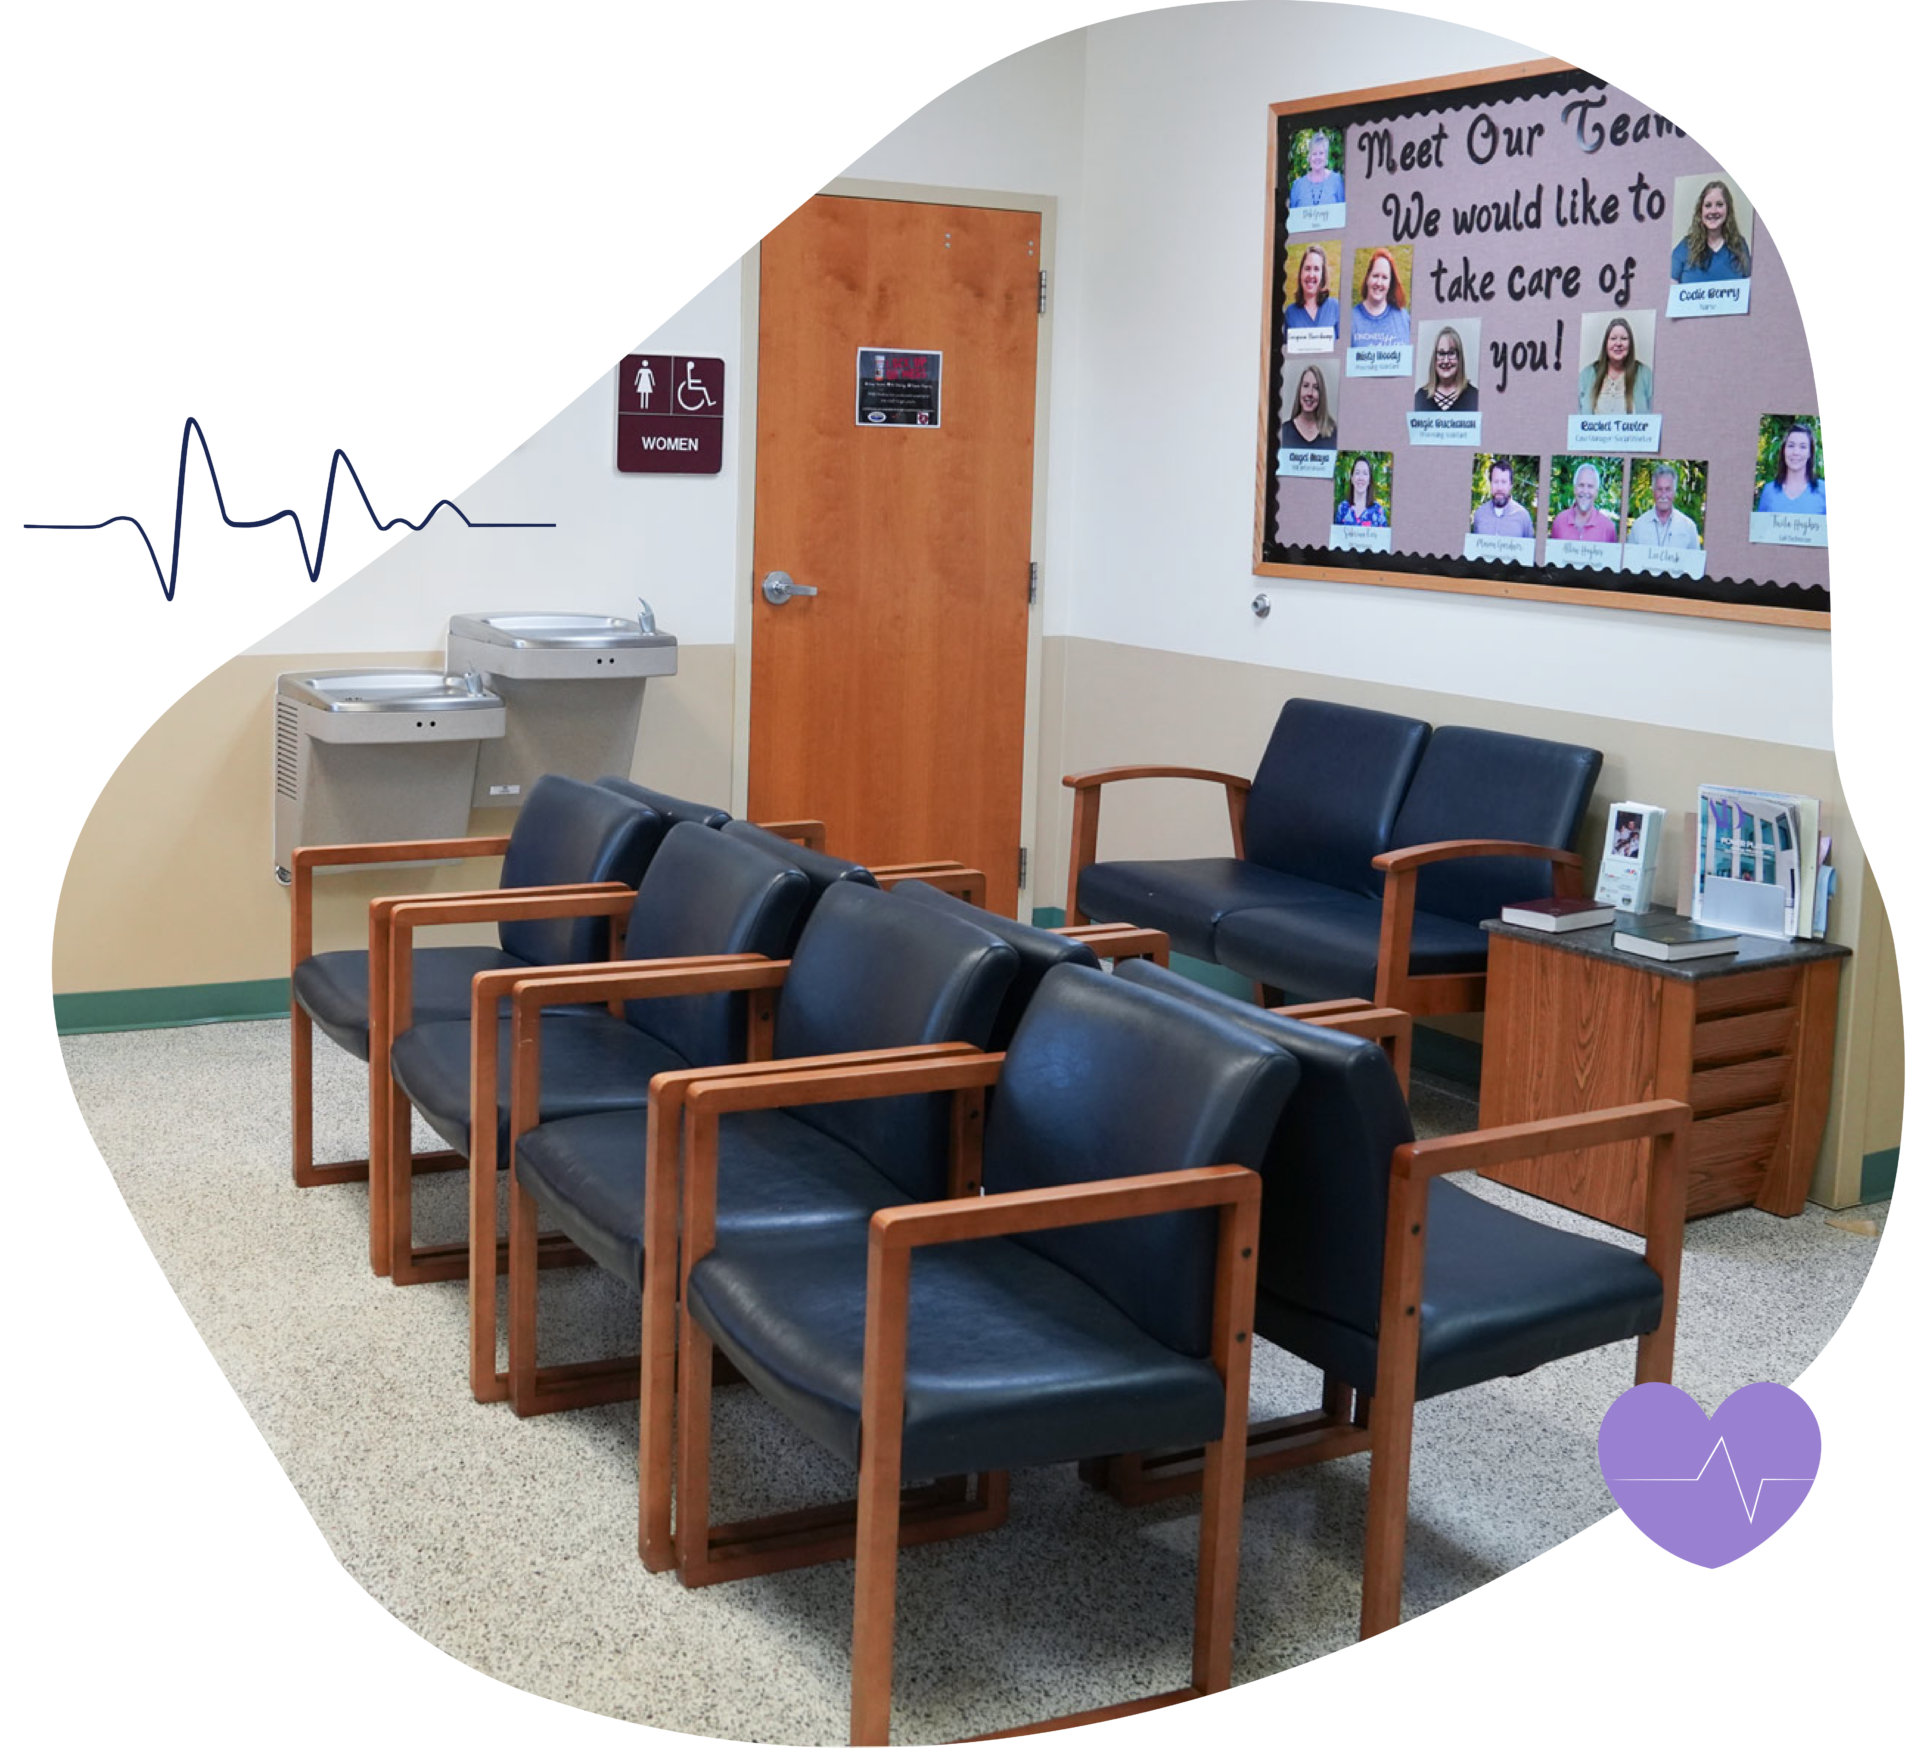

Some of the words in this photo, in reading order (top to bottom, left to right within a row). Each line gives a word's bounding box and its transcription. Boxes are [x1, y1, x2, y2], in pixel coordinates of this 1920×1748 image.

[1357, 122, 1450, 180] Meet
[1466, 113, 1546, 165] Our
[1382, 190, 1441, 243] We
[1452, 183, 1544, 236] would
[1556, 177, 1620, 227] like
[1628, 171, 1667, 223] to
[1430, 256, 1496, 304] take
[1507, 265, 1581, 302] care
[1598, 256, 1638, 308] of
[1707, 287, 1740, 302] Berry
[1489, 319, 1565, 394] you!
[641, 435, 699, 452] WOMEN
